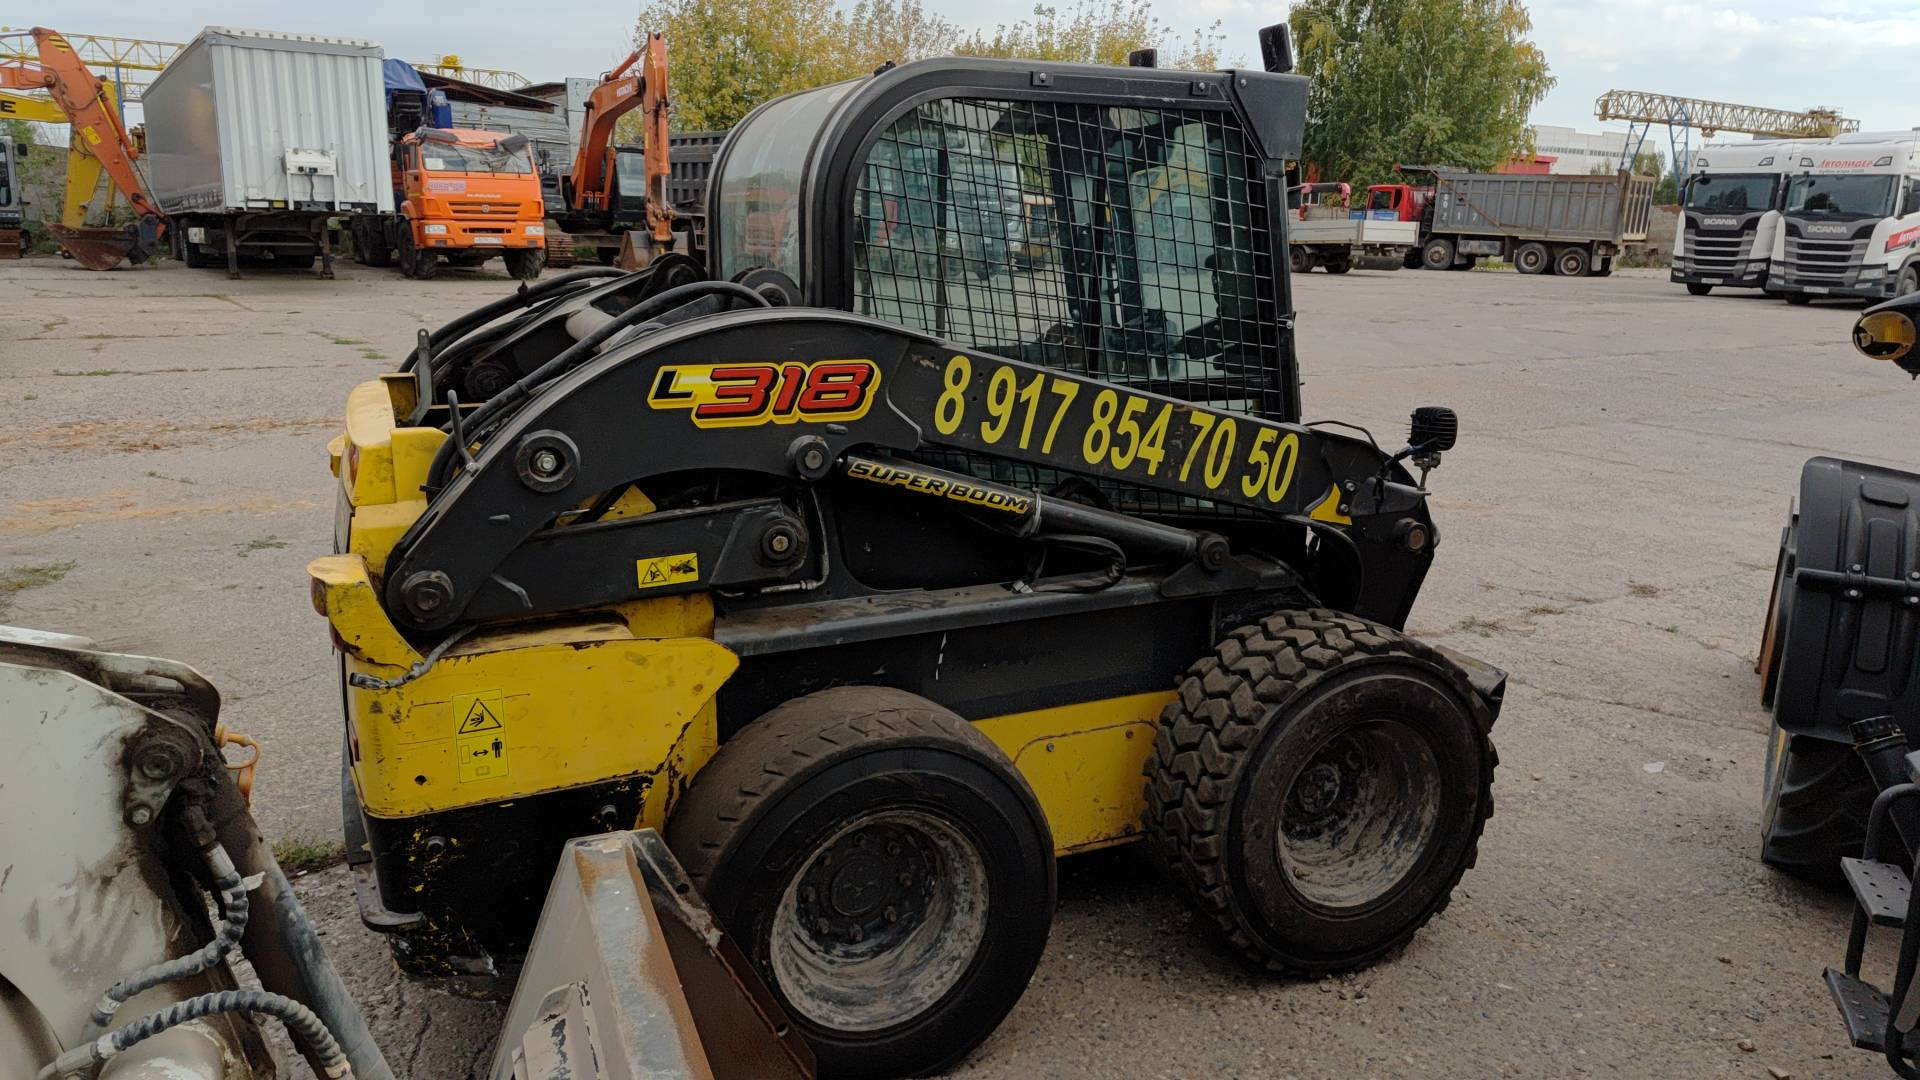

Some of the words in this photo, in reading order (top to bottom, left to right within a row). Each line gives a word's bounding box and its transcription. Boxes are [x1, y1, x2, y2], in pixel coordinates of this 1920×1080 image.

[1703, 218, 1738, 226] SCANIA
[1806, 225, 1848, 234] SCANIA
[648, 361, 879, 424] L318
[935, 355, 972, 435] 8
[981, 366, 1080, 454] 917
[1083, 389, 1174, 476] 854
[1179, 410, 1237, 489] 70
[1242, 427, 1299, 503] 50
[850, 461, 948, 497] SUPER
[949, 483, 1030, 514] BOOM
